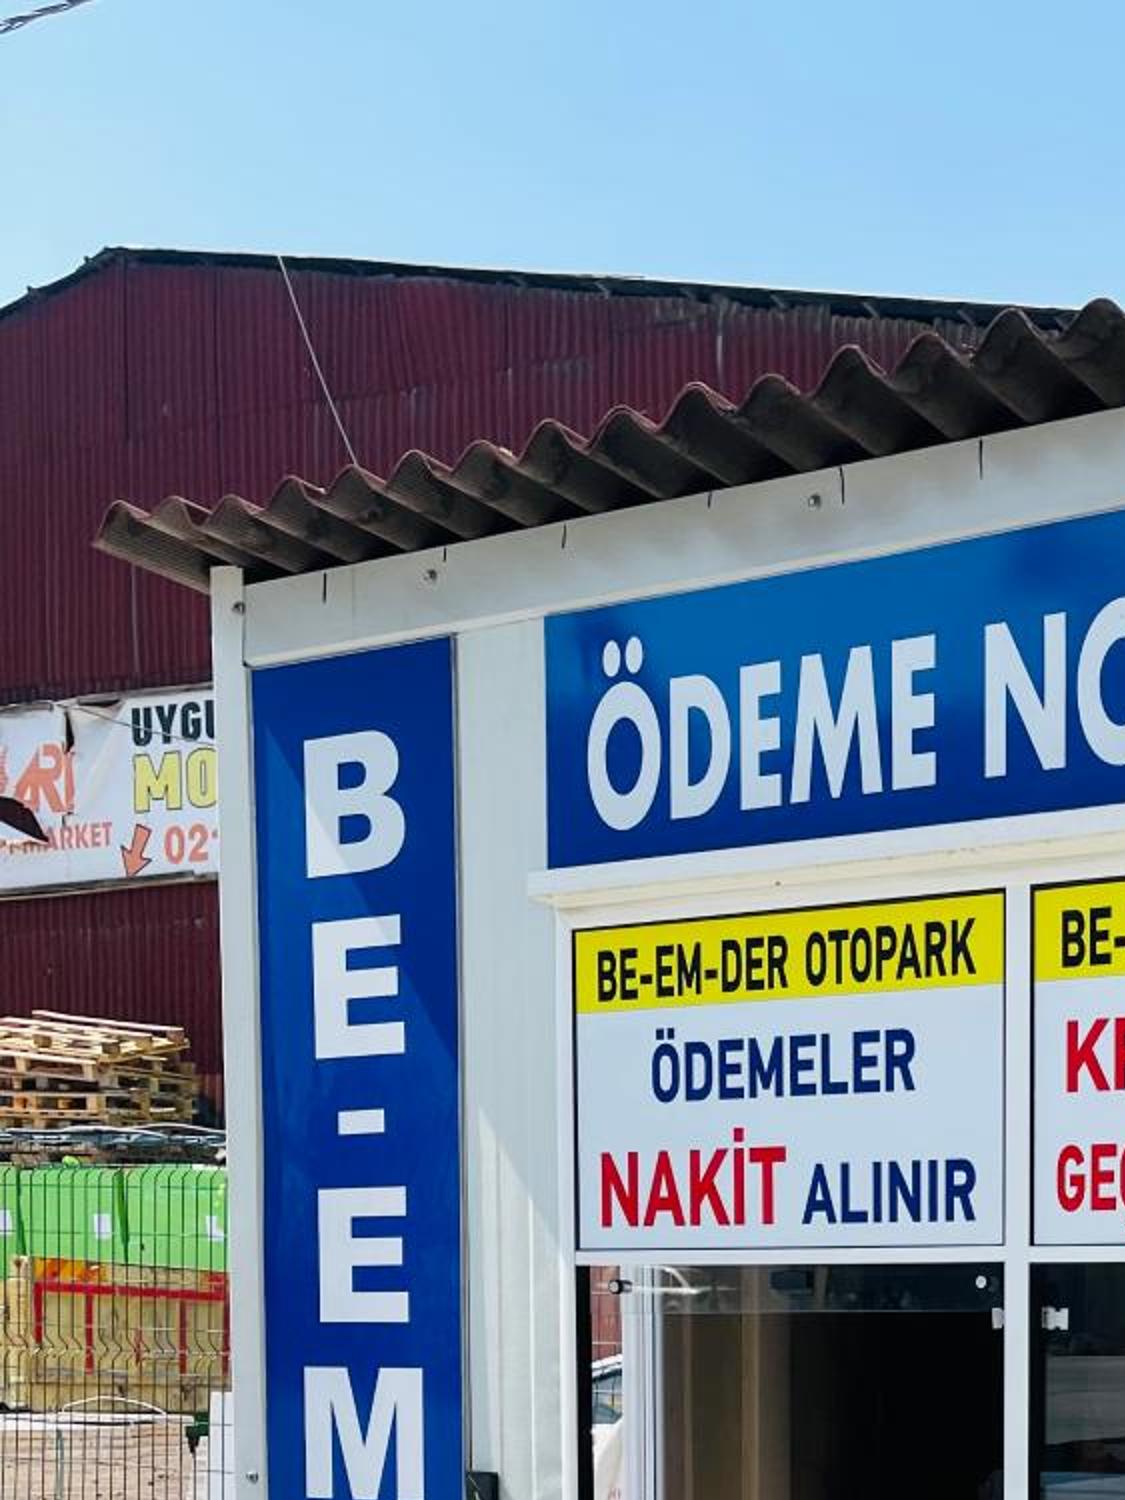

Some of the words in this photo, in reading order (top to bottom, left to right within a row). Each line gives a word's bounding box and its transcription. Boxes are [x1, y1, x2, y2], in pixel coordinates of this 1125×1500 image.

[588, 635, 937, 831] ÖDEME
[164, 823, 218, 865] 02
[597, 934, 788, 1002] BE-EM-DER
[805, 918, 976, 987] OTOPARK
[651, 1027, 915, 1103] ÖDEMELER
[601, 1127, 786, 1228] NAKİT
[802, 1158, 976, 1225] ALINIR
